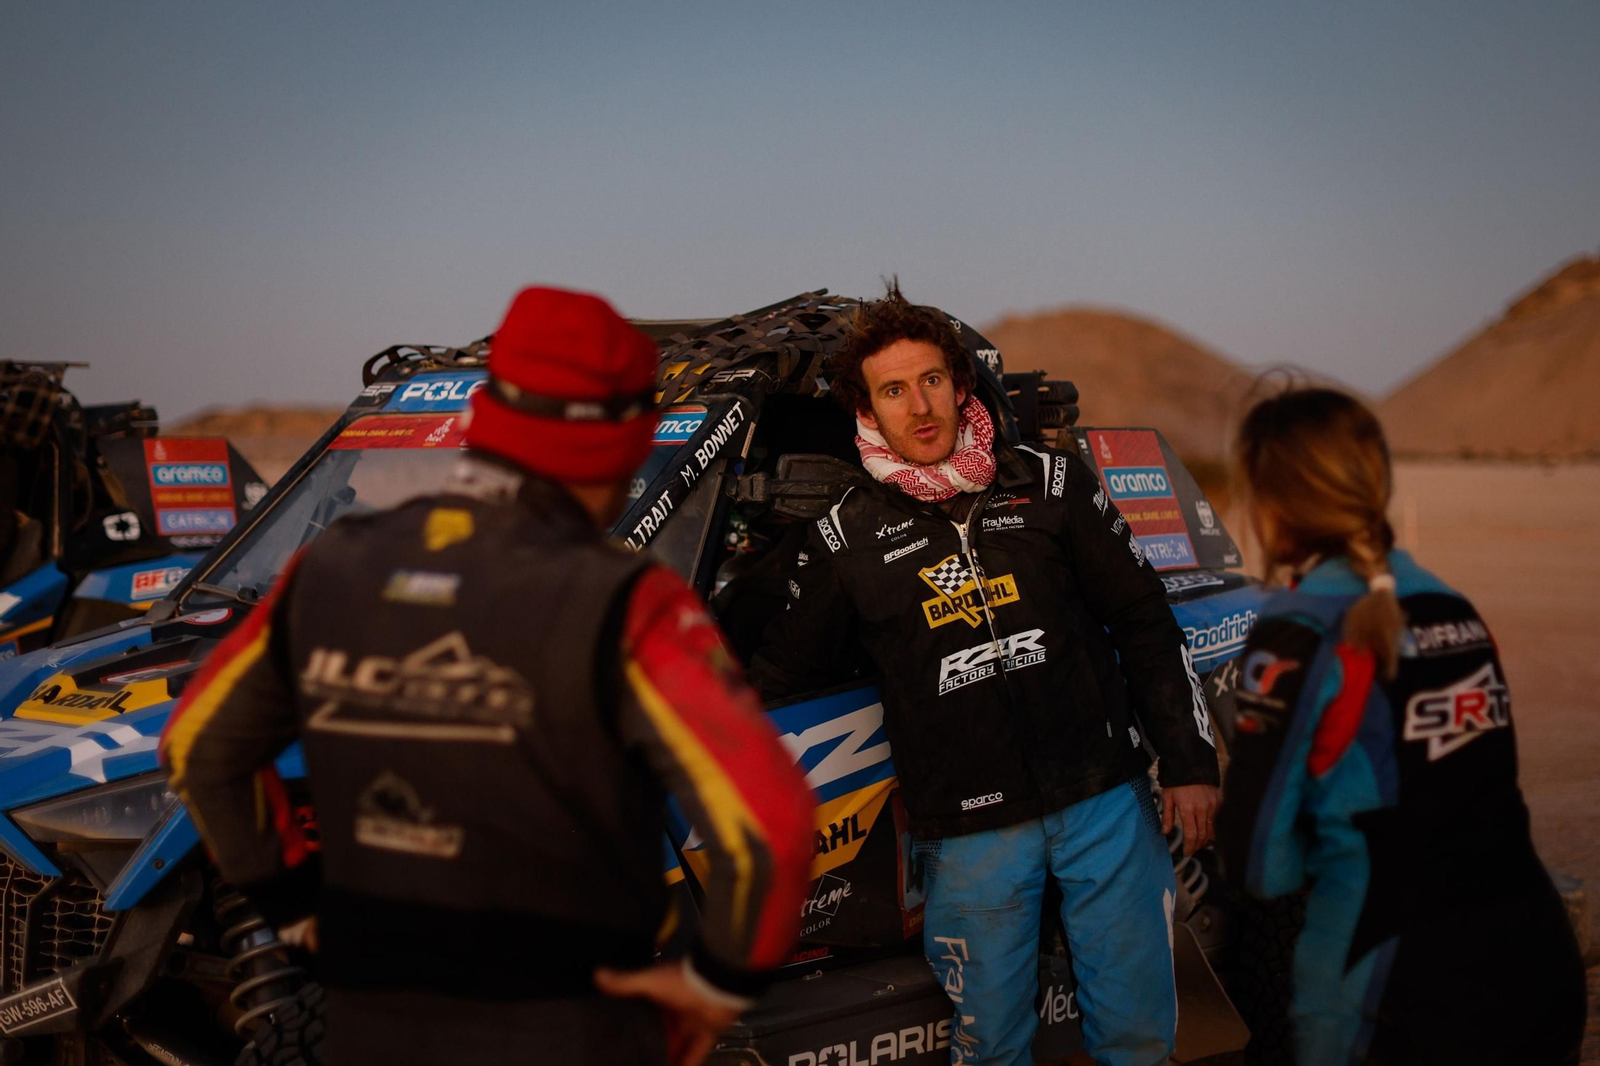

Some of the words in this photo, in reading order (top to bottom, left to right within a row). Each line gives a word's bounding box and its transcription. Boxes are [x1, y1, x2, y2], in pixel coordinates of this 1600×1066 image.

[655, 419, 703, 433] mco
[680, 464, 700, 488] M.
[694, 400, 745, 470] BONNET
[157, 465, 224, 483] aramco
[1051, 455, 1066, 498] sparco
[1110, 472, 1167, 494] aramco
[883, 537, 929, 562] BFGoodrich
[939, 664, 997, 693] FACTORY
[961, 791, 1004, 811] sparco
[814, 812, 867, 857] AHL
[801, 881, 853, 918] treme
[799, 917, 831, 938] COLOR
[794, 946, 830, 964] ACING
[0, 989, 66, 1026] GW-596-AF
